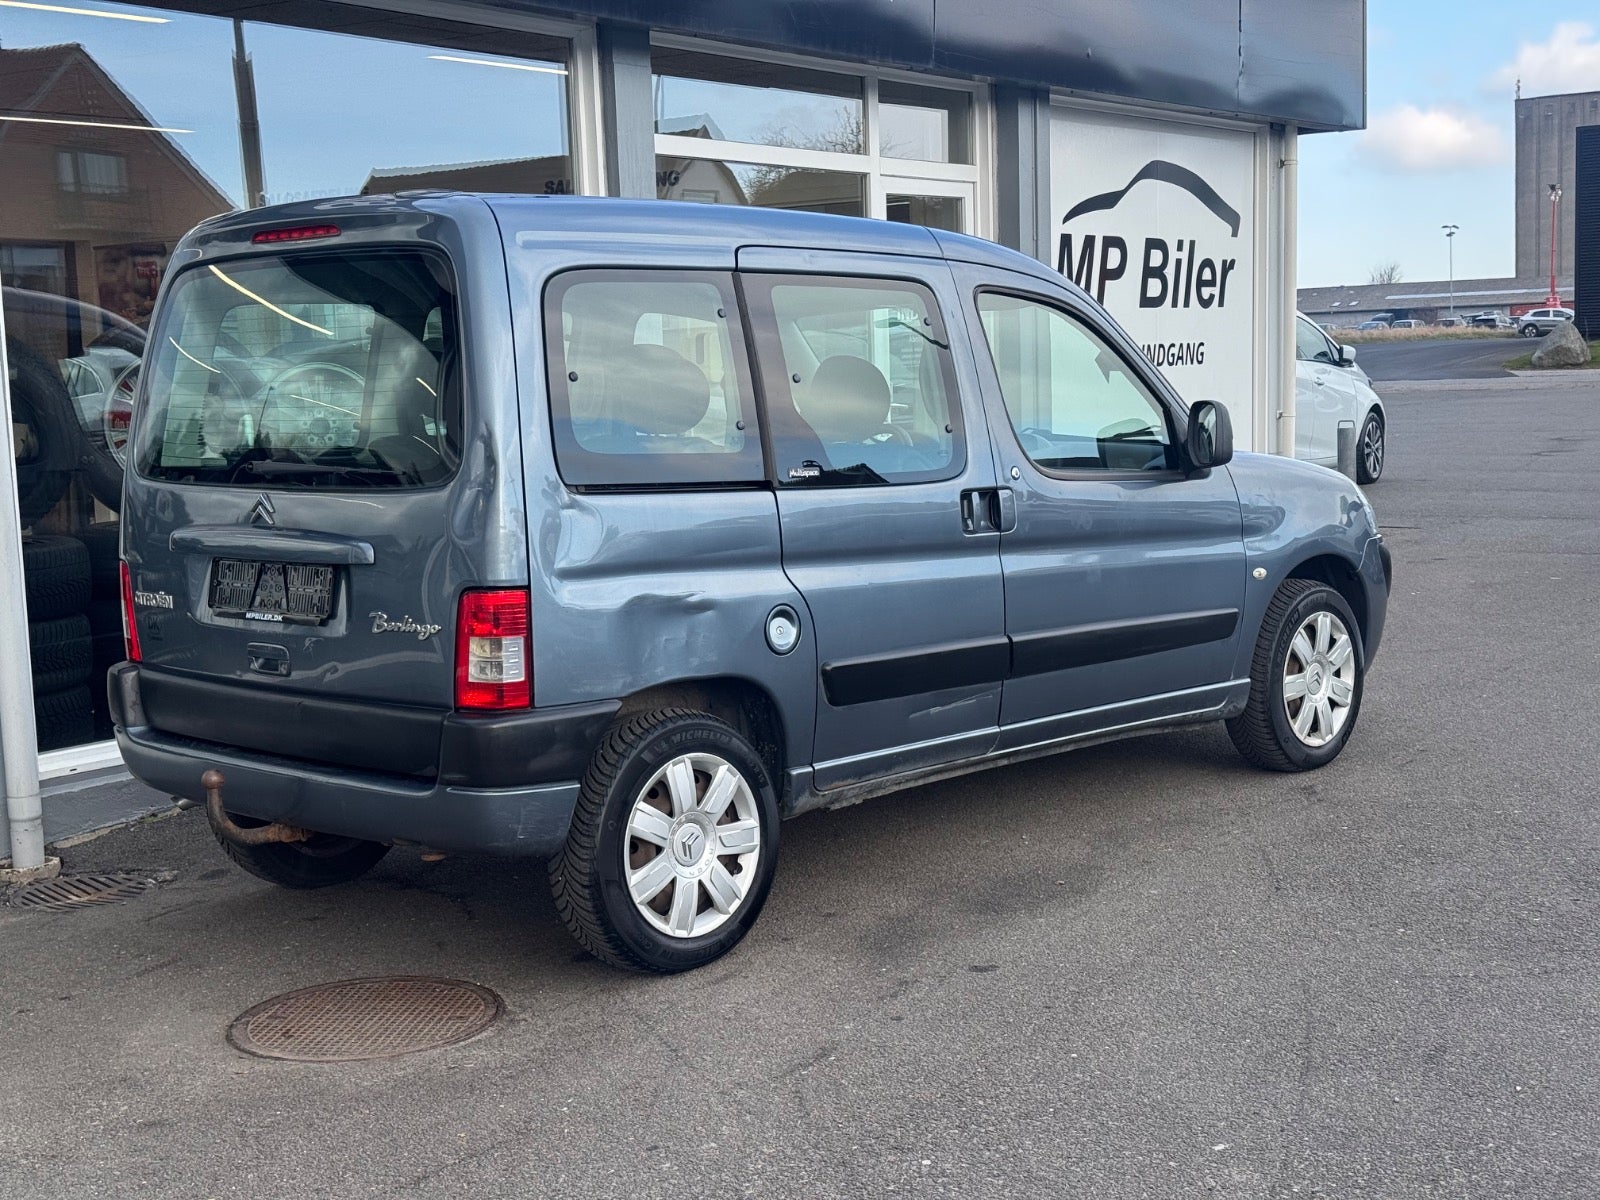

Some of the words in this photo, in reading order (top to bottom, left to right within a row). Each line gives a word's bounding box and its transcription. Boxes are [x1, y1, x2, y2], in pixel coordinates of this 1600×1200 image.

[1057, 233, 1128, 307] MP
[1139, 237, 1236, 310] Biler
[369, 611, 442, 641] Berlingo
[671, 728, 731, 745] MICHELIN
